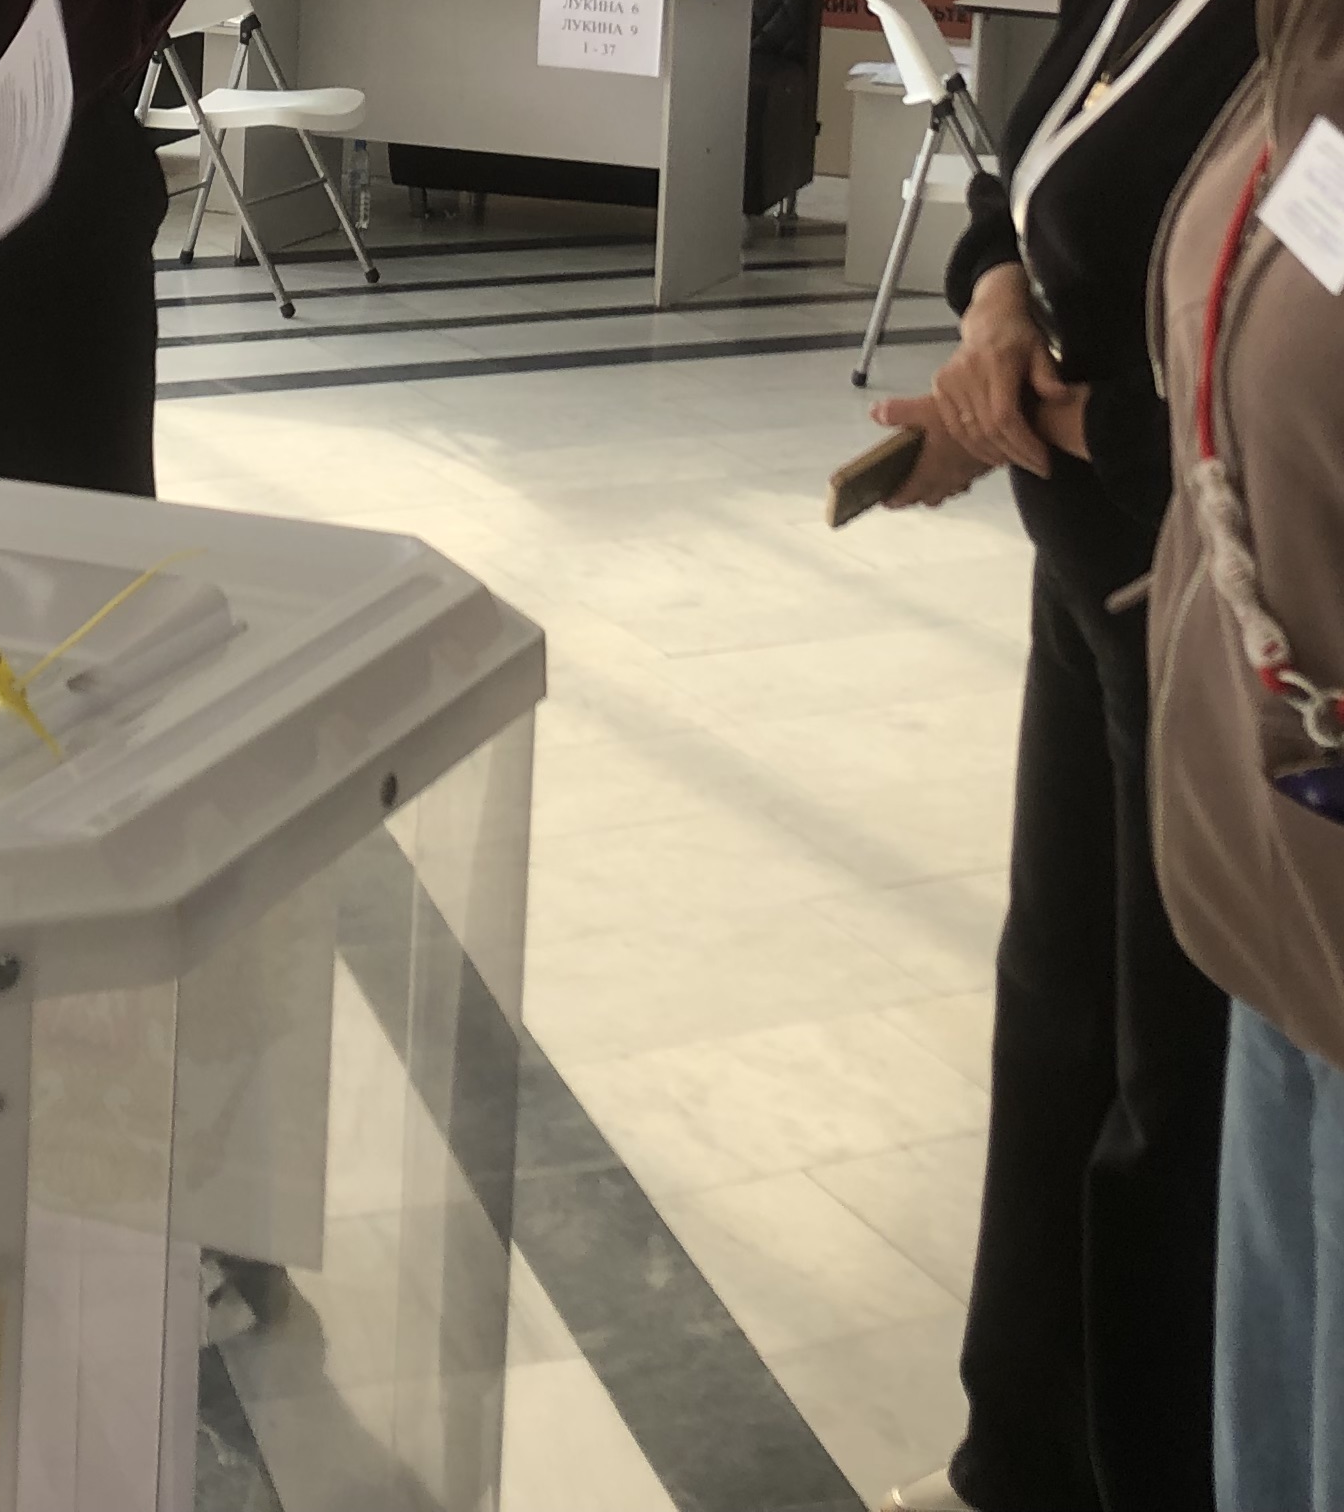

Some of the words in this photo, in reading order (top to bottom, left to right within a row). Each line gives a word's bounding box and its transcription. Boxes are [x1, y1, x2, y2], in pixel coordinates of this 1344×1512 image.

[630, 2, 640, 14] 6
[561, 17, 623, 36] ЛУКИНА
[630, 24, 639, 36] 9
